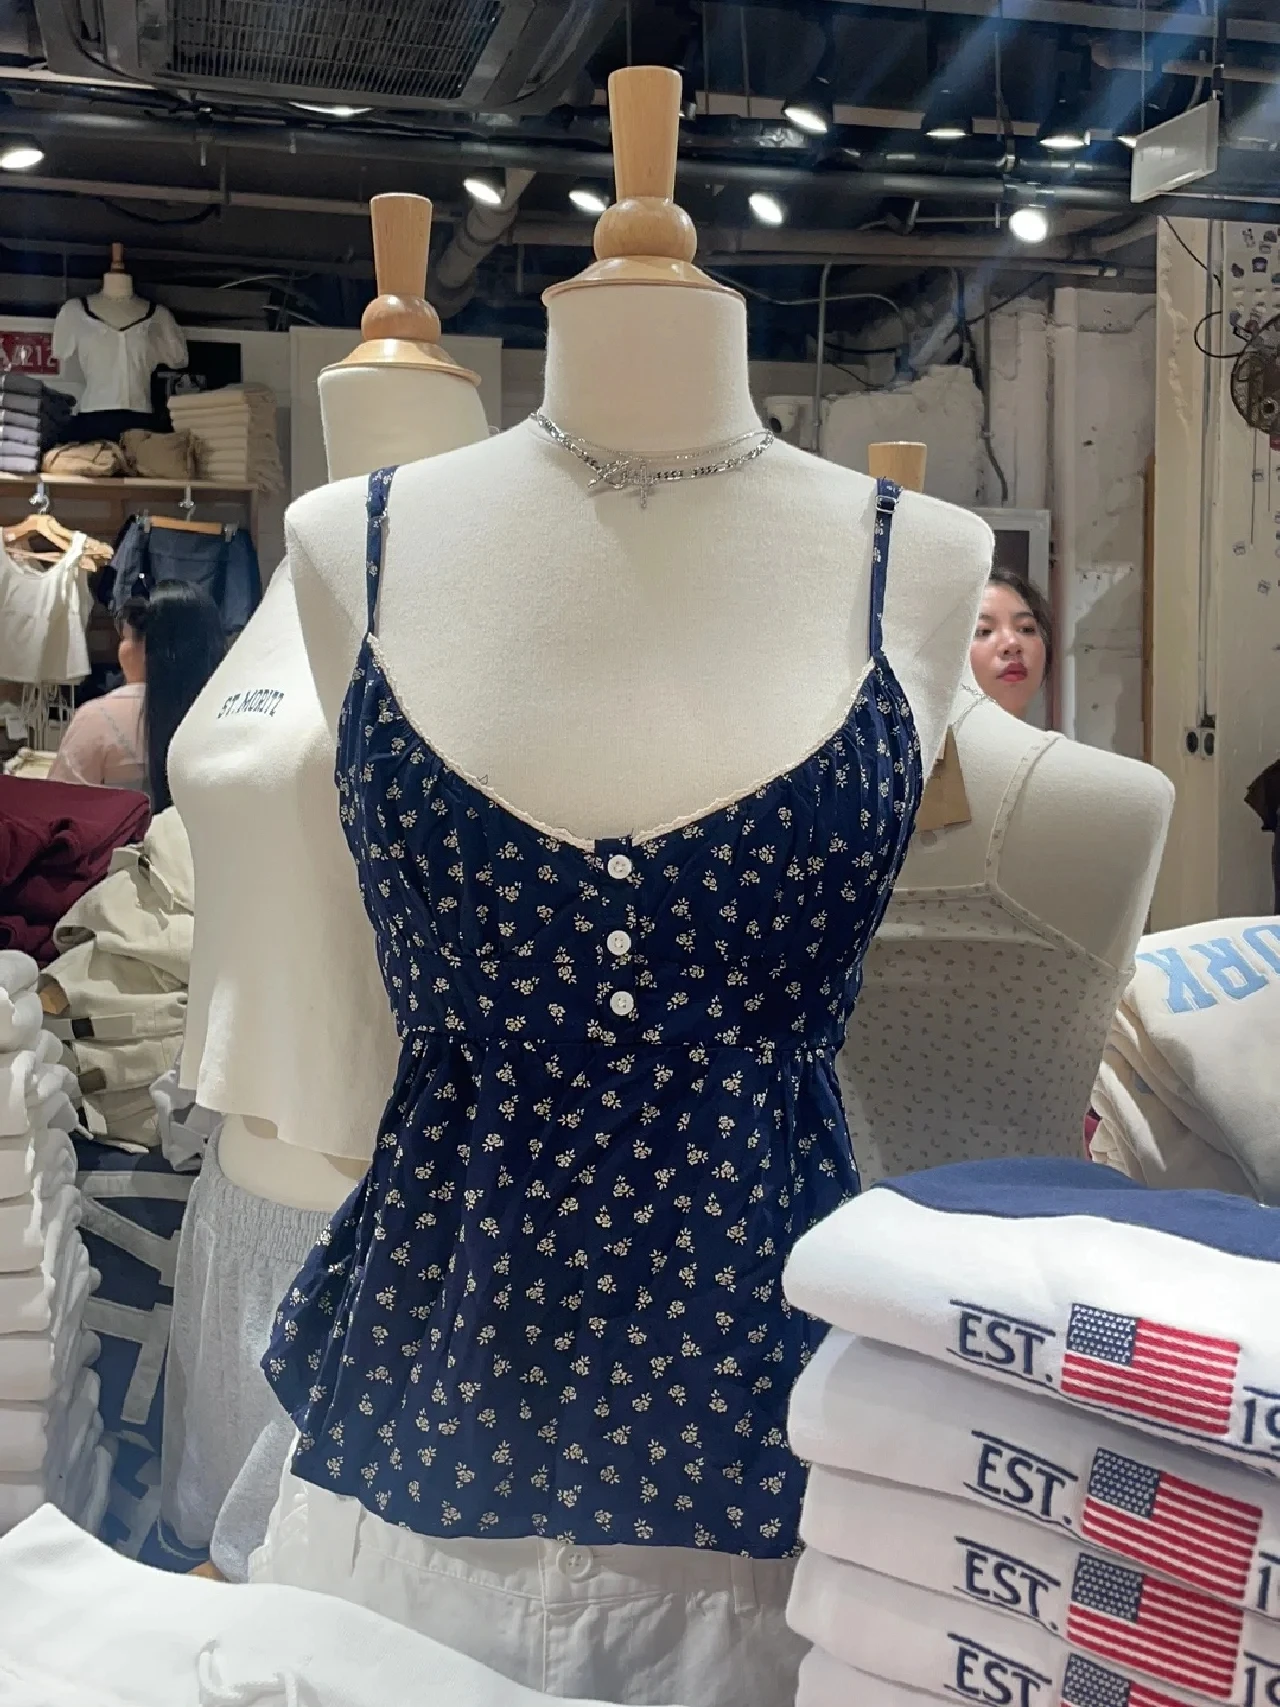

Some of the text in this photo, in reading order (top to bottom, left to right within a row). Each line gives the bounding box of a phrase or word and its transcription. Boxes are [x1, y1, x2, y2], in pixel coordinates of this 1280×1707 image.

[236, 689, 285, 717] MORITZ
[959, 1311, 1054, 1383] EST.
[977, 1442, 1072, 1526] EST.
[965, 1549, 1059, 1631] EST.
